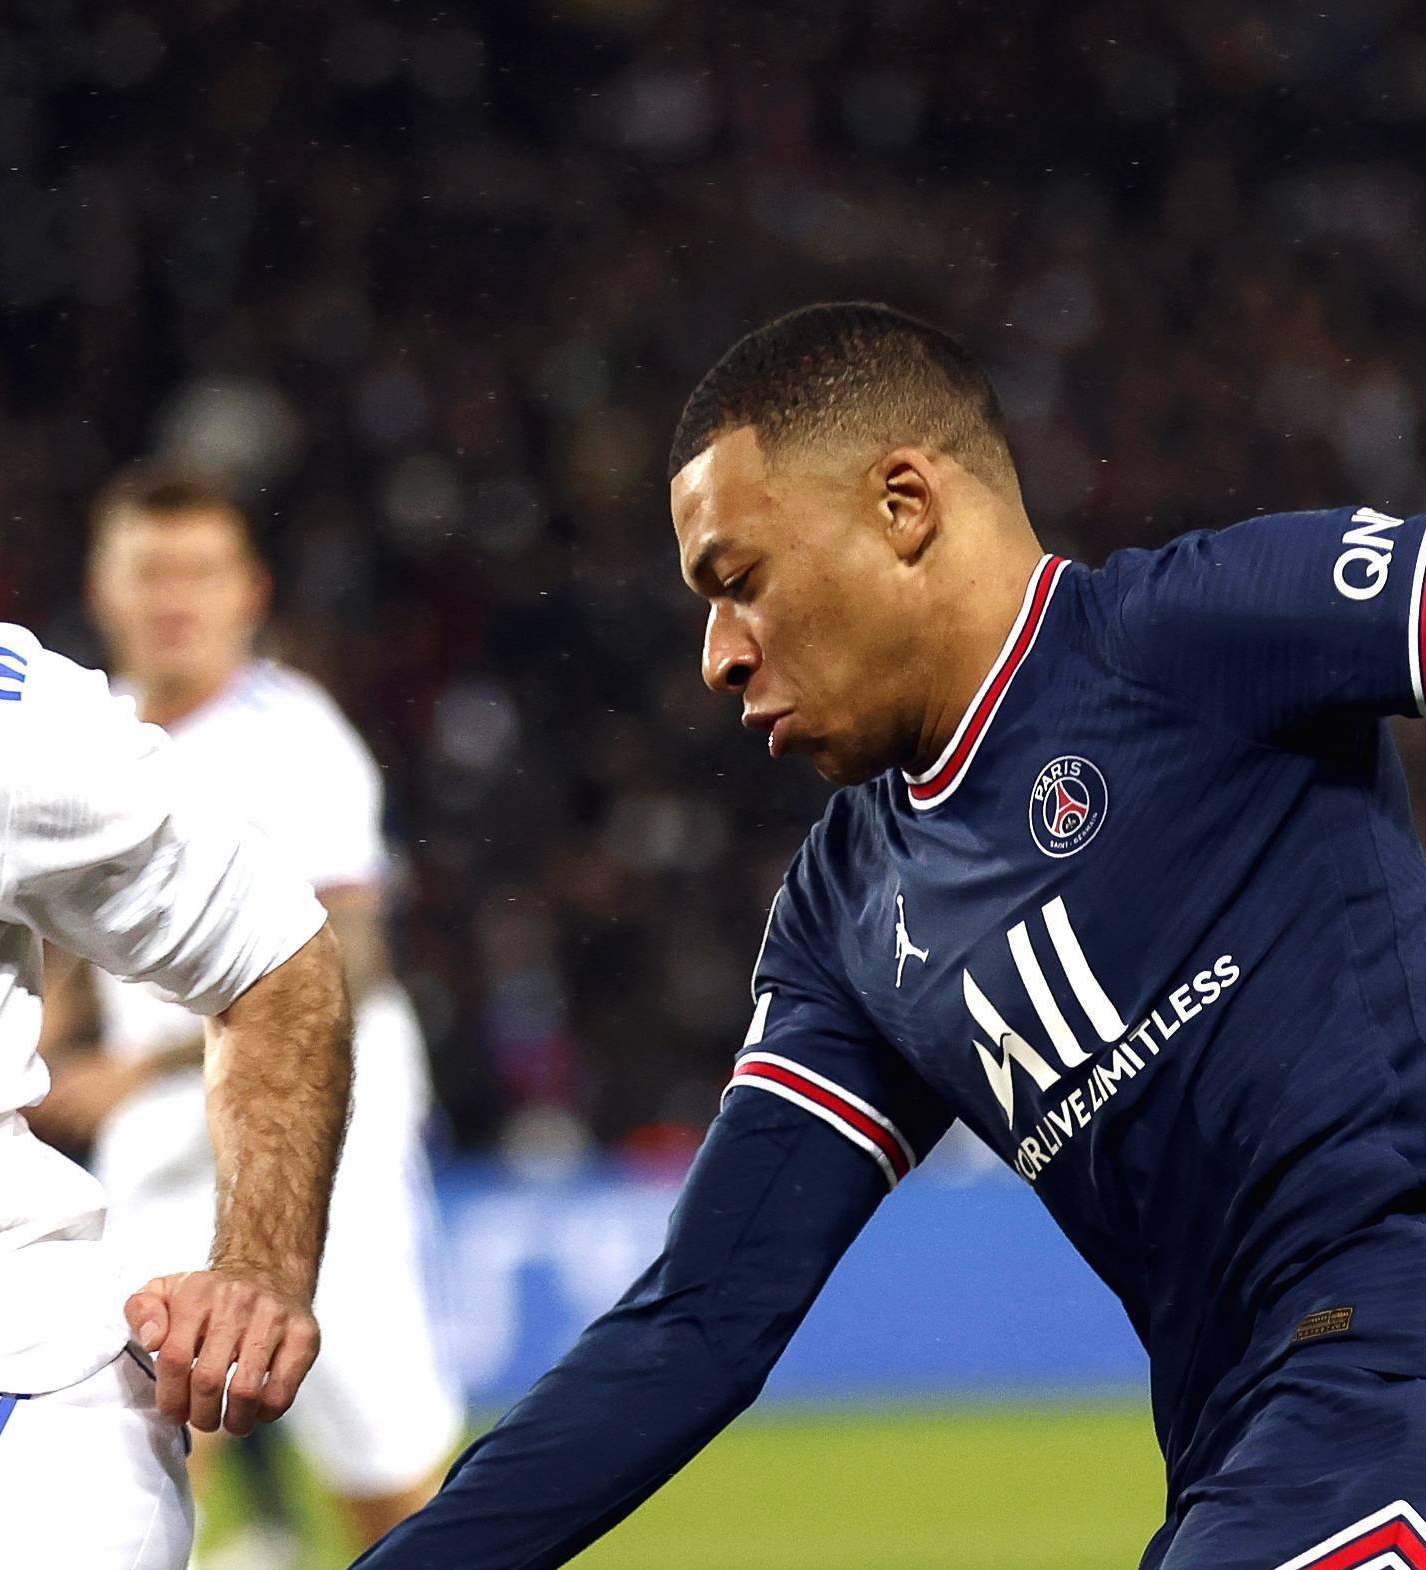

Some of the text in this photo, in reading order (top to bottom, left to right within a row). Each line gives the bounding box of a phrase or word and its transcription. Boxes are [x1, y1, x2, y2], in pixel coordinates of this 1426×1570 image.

[1035, 761, 1082, 801] PARIS
[1036, 1088, 1092, 1156] LIVE
[1087, 955, 1241, 1112] LIMITLESS
